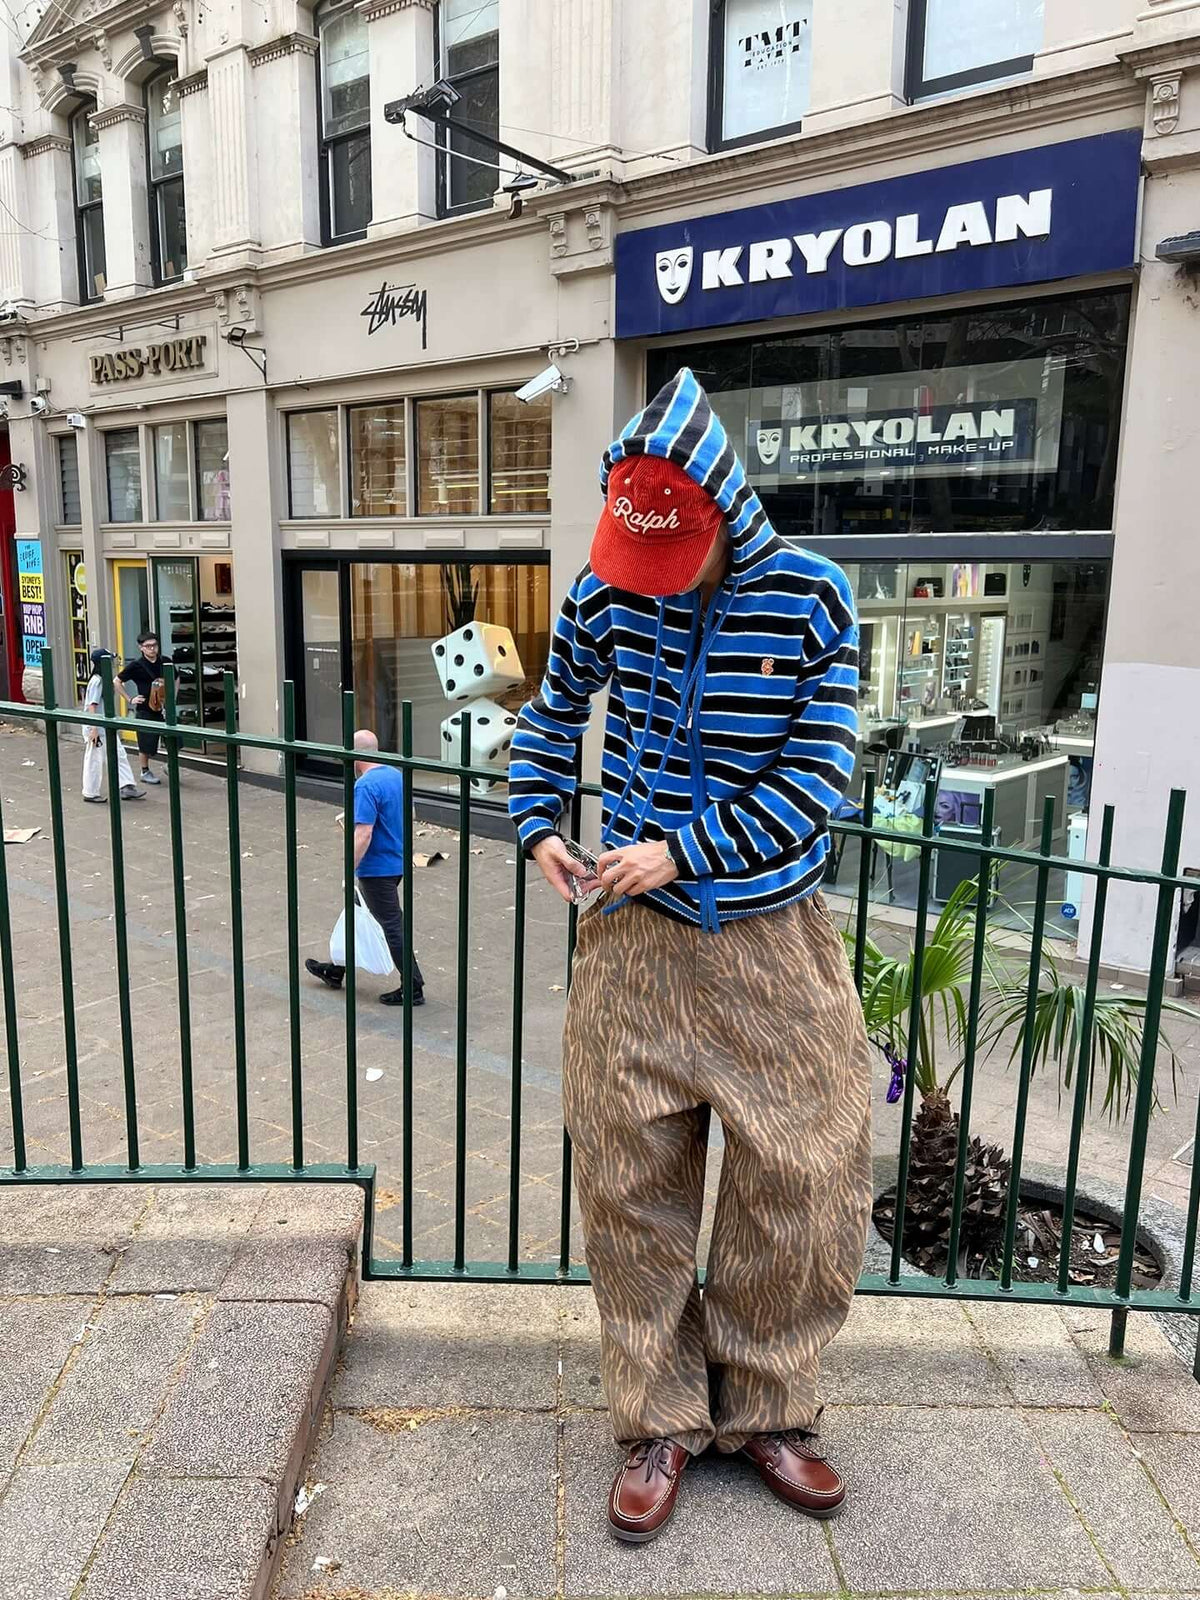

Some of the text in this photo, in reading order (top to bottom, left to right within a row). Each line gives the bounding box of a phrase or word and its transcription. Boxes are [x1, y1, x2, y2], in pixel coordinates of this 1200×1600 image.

[738, 18, 808, 68] TMT
[752, 41, 793, 57] EDUCATION
[702, 188, 1053, 291] KRYOLAN
[789, 408, 1016, 452] KRYOLAN
[789, 440, 1015, 464] PROFESSIONAL MAKE-UP
[613, 496, 680, 534] Ralph
[22, 585, 42, 599] BEST!
[24, 614, 44, 635] RNB
